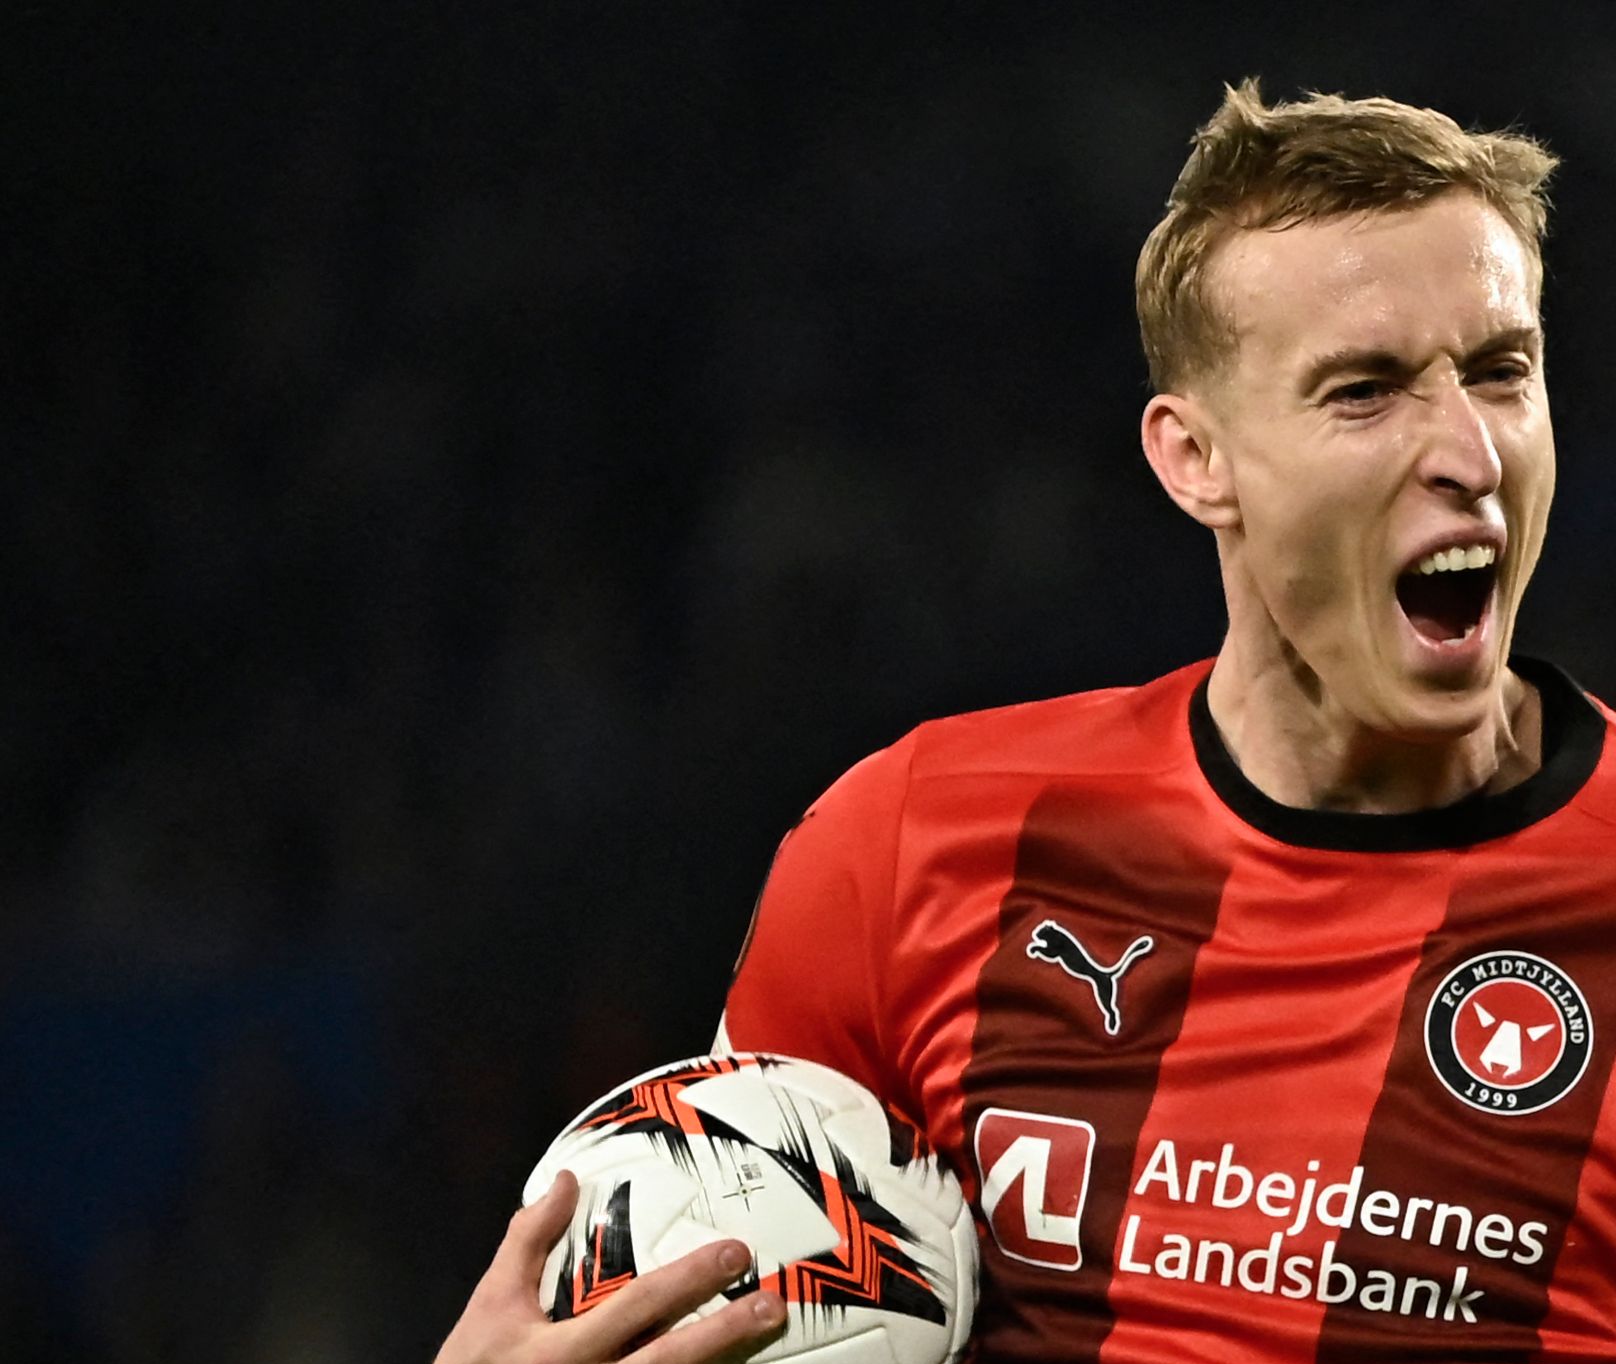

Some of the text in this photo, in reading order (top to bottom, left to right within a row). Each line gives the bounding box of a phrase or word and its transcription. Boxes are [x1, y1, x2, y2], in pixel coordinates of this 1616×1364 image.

[1441, 959, 1585, 1044] FC MIDTJYLLAND
[1465, 1082, 1518, 1108] 1999
[1133, 1139, 1549, 1265] Arbejdernes
[1118, 1214, 1485, 1324] Landsbank
